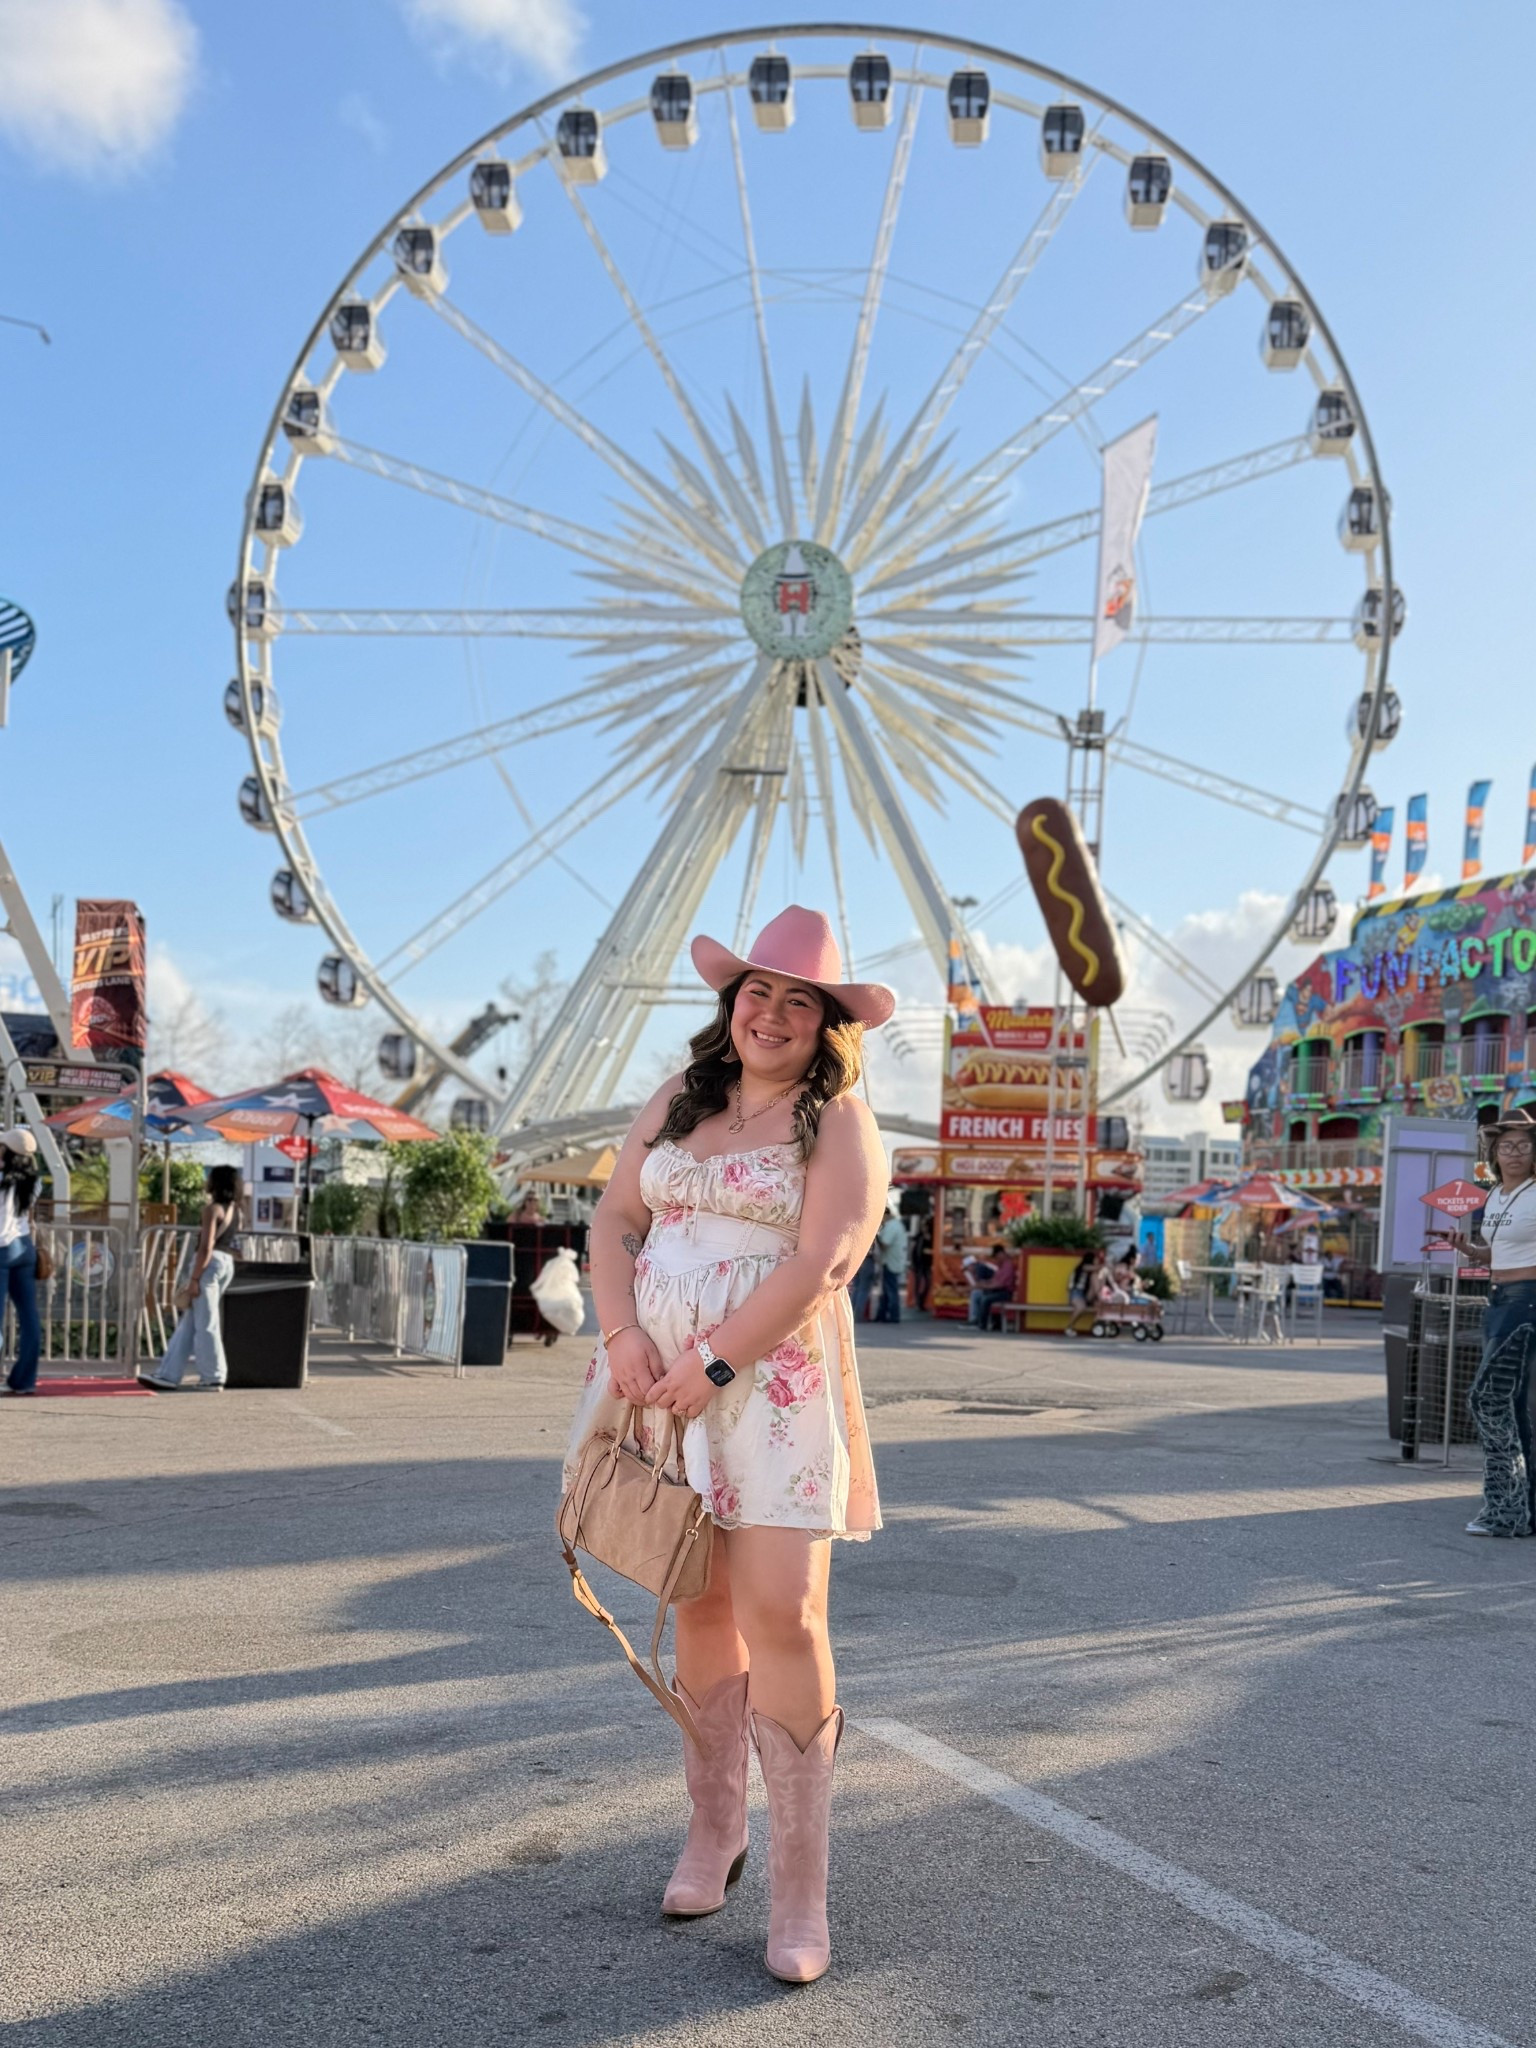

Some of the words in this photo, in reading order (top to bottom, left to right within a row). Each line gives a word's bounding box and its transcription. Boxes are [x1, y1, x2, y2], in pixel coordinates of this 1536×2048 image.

[76, 944, 131, 976] VIP
[105, 975, 131, 986] LANE
[1335, 951, 1411, 1004] FUN
[28, 1069, 56, 1083] VIP
[949, 1116, 1024, 1138] FRENCH
[1031, 1118, 1083, 1140] FRIES
[1455, 1181, 1463, 1196] 7
[1437, 1197, 1464, 1205] TICKETS
[1465, 1197, 1480, 1205] PER
[1447, 1204, 1468, 1212] RIDER
